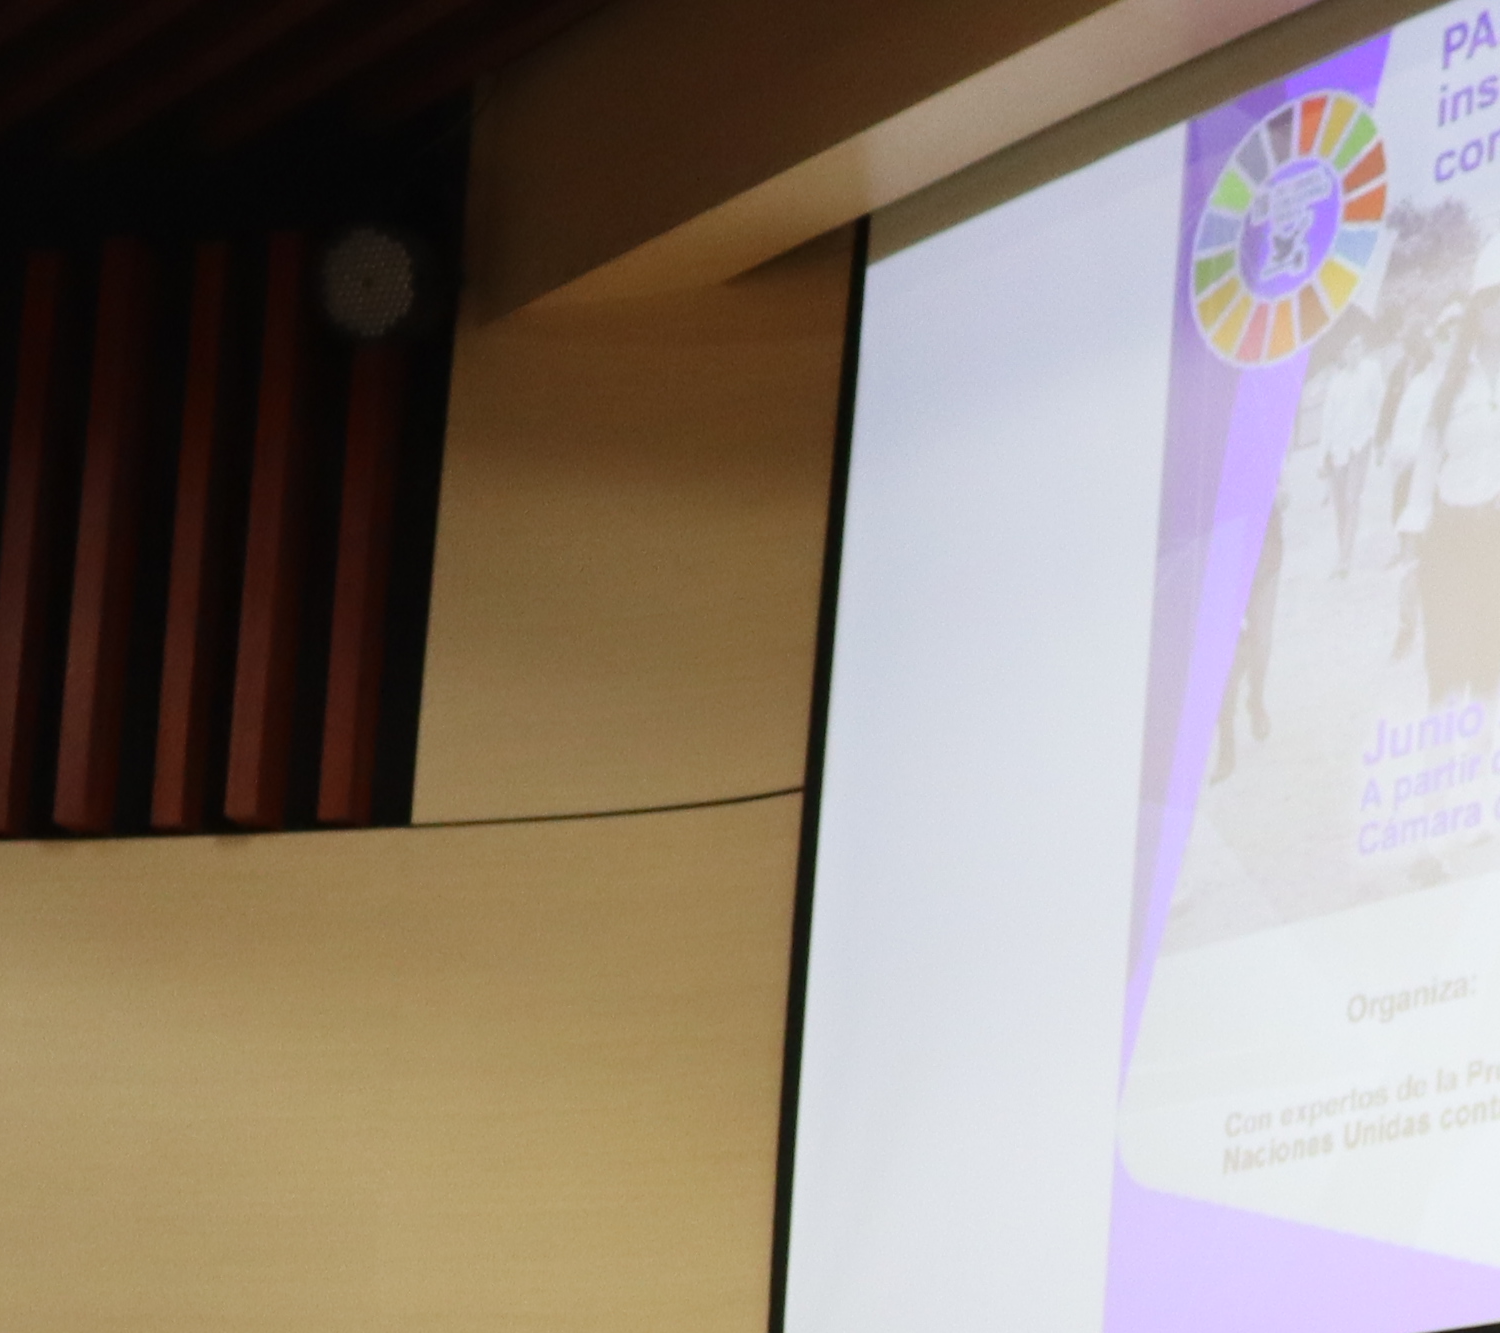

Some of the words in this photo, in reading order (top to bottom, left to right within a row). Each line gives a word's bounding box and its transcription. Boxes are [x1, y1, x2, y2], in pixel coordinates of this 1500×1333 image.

[1361, 697, 1486, 767] Junio
[1359, 778, 1383, 812] A
[1392, 752, 1483, 809] partir
[1356, 802, 1483, 856] Cámara
[1346, 973, 1478, 1026] Organiza:
[1223, 1107, 1273, 1139] Con
[1279, 1088, 1389, 1131] expertos
[1395, 1074, 1428, 1105] de
[1435, 1068, 1459, 1093] la
[1221, 1129, 1334, 1176] Naciones
[1342, 1112, 1432, 1151] Unidas
